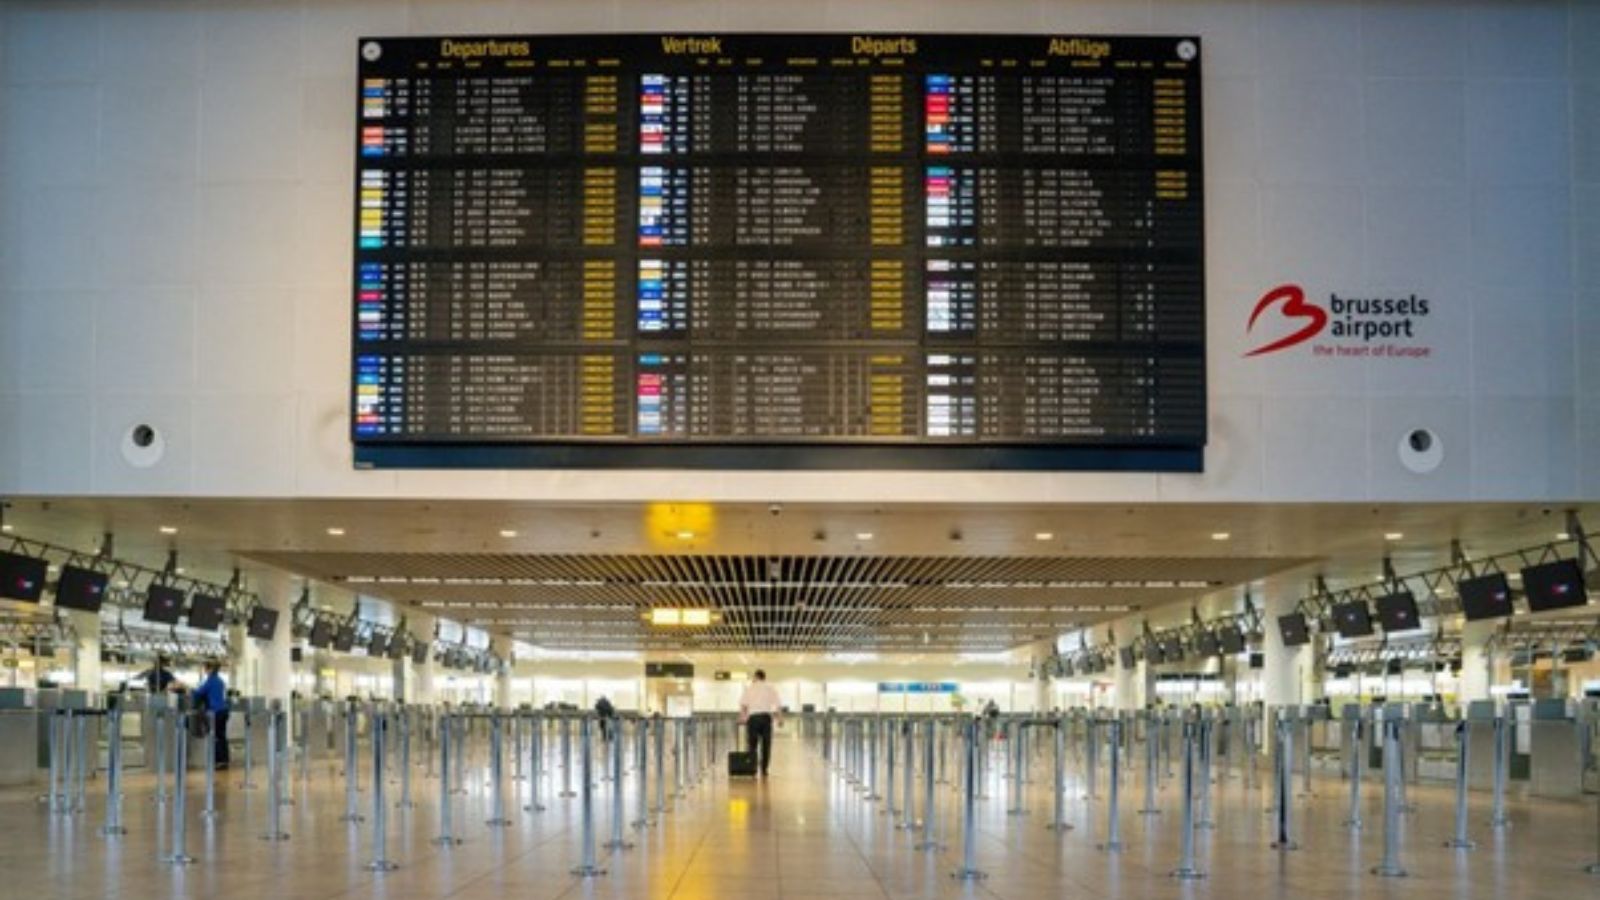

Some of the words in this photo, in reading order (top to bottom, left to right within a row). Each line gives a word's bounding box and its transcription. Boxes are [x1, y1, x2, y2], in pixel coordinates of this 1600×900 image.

[441, 40, 530, 59] Departures
[661, 37, 721, 54] Vertrek
[852, 36, 917, 56] Départs
[1048, 38, 1110, 57] Abflüge
[1331, 293, 1430, 314] brussels
[1331, 316, 1413, 341] airport
[1313, 344, 1334, 356] the
[1337, 344, 1369, 356] heart
[1372, 344, 1386, 356] of
[1387, 345, 1431, 358] Europe
